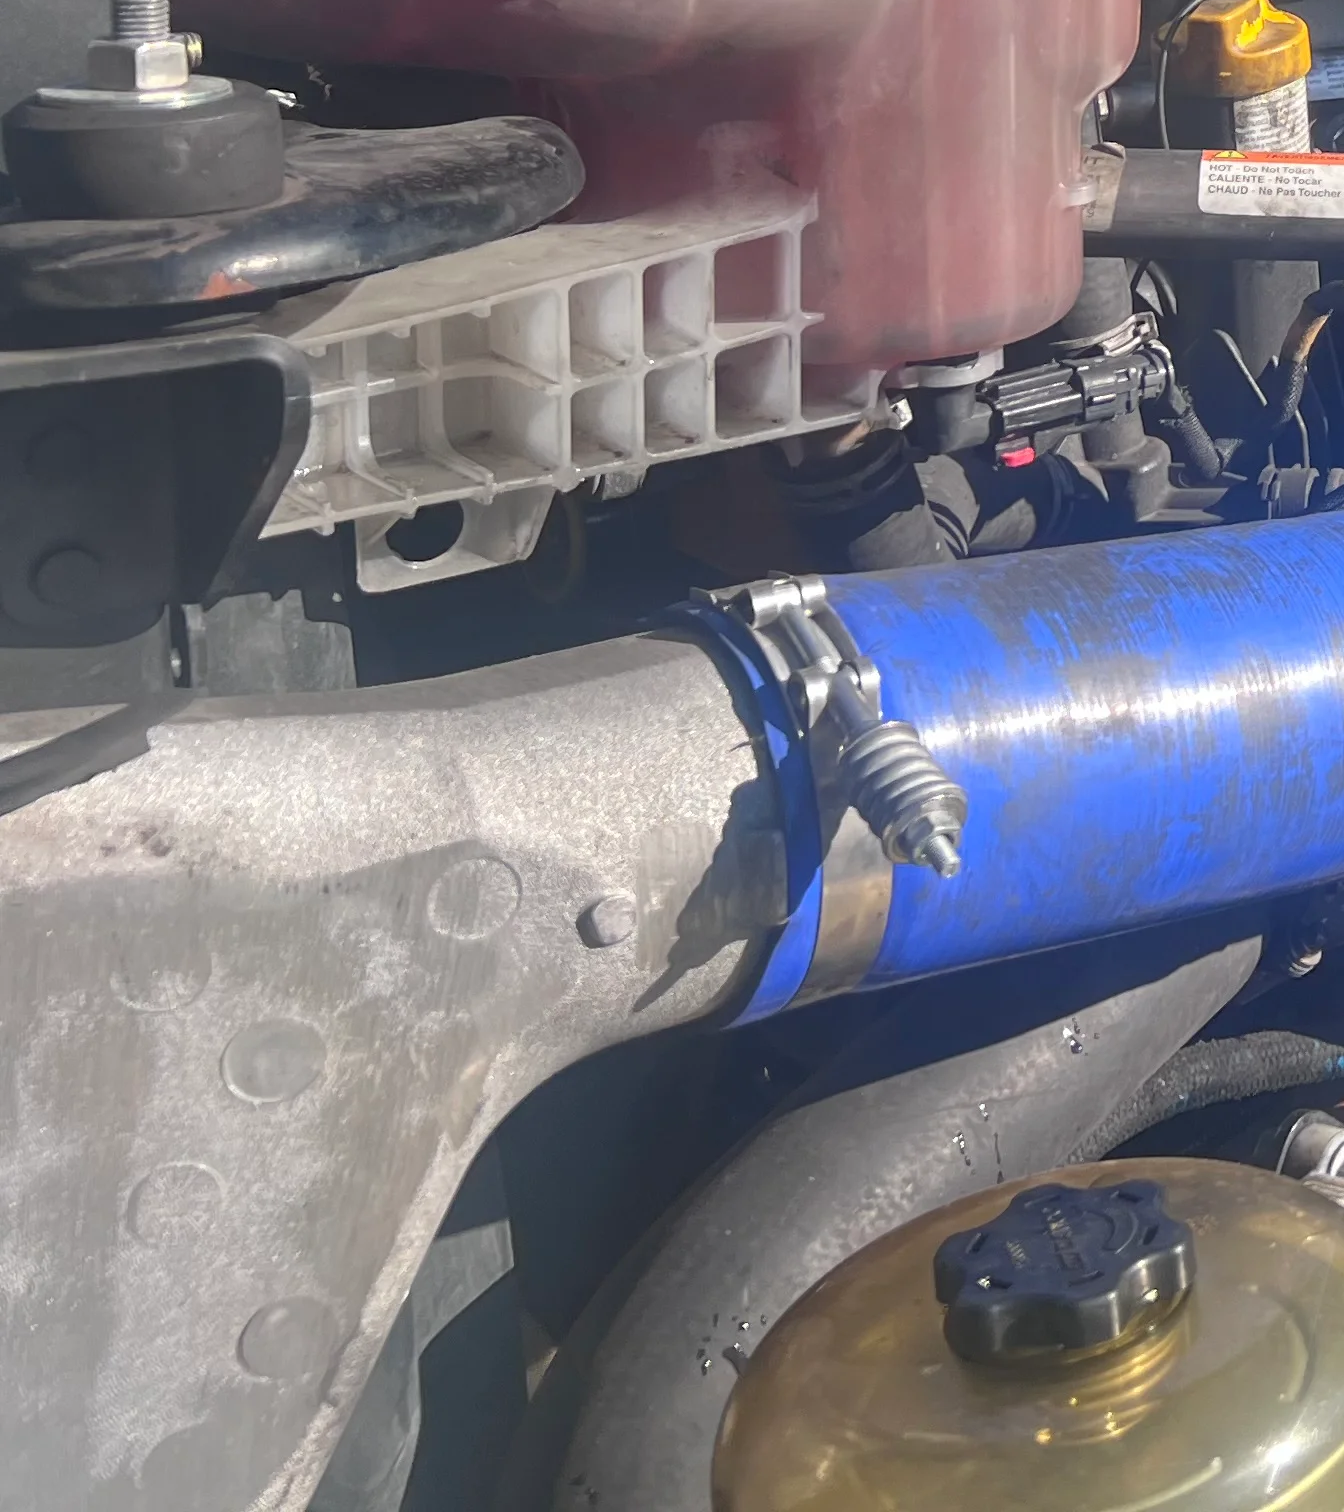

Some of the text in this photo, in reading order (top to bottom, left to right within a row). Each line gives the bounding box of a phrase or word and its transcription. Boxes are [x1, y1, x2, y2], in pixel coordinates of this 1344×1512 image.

[1209, 164, 1233, 172] HOT
[1243, 165, 1258, 173] Do
[1262, 166, 1280, 174] Not
[1282, 167, 1315, 175] Touch
[1208, 174, 1265, 184] CALIENTE
[1275, 176, 1290, 185] No
[1293, 177, 1323, 186] Tocar
[1207, 185, 1249, 195] CHAUD
[1259, 187, 1273, 196] Ne
[1276, 188, 1296, 197] Pas
[1298, 188, 1341, 198] Toucher
